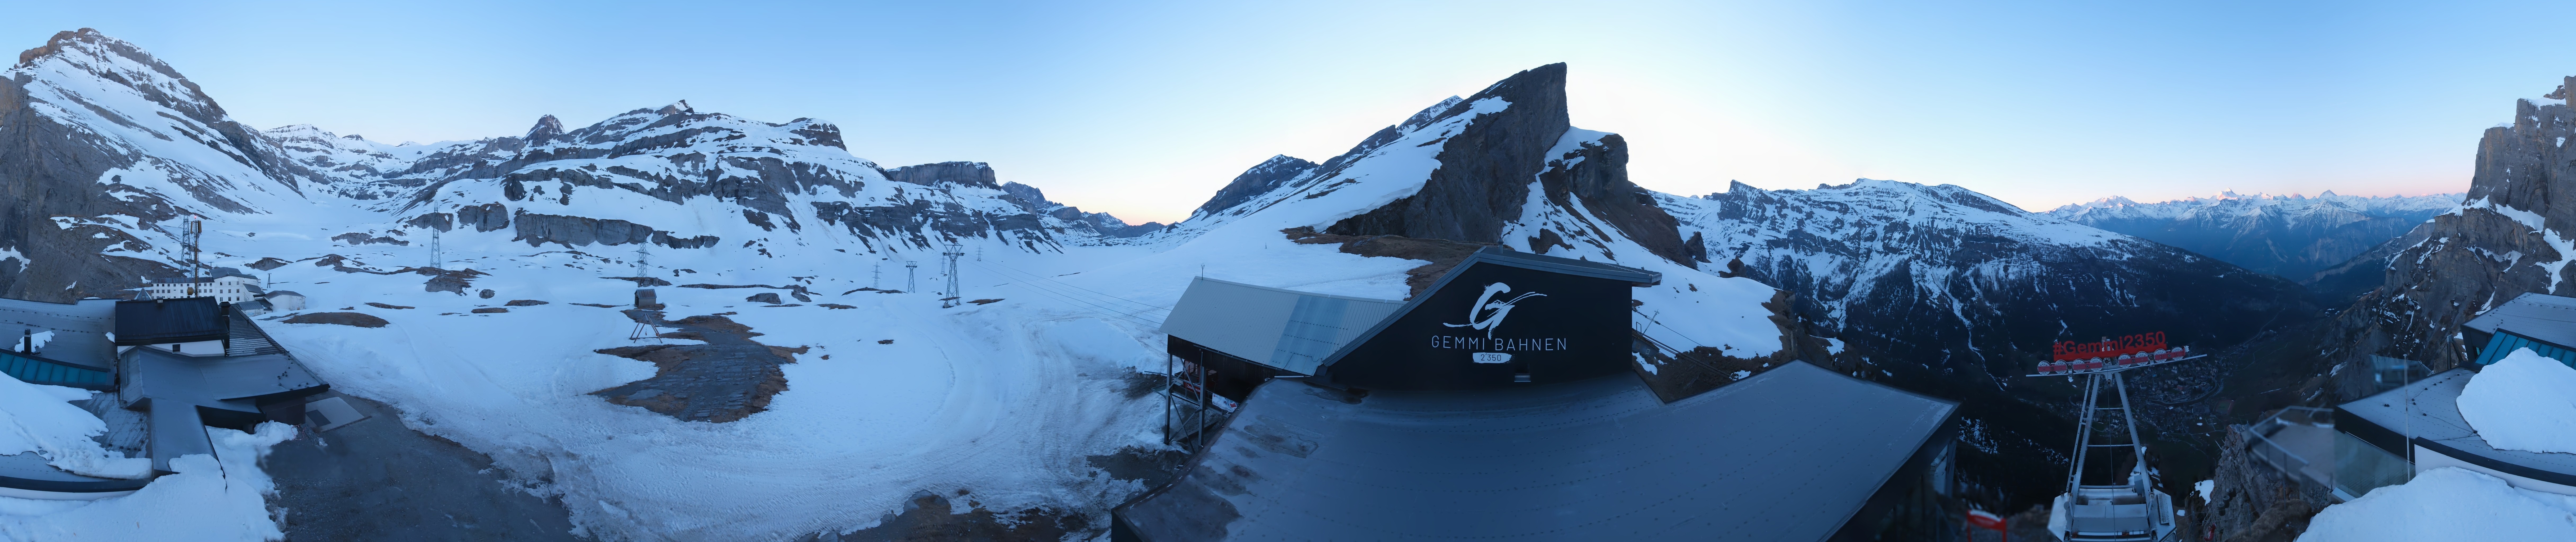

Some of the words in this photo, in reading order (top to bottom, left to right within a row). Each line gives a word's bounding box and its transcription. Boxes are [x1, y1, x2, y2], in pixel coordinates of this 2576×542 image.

[1432, 335, 1484, 350] GEMMI
[1495, 338, 1566, 351] BAHNEN
[2053, 331, 2166, 355] #Gemmi2350
